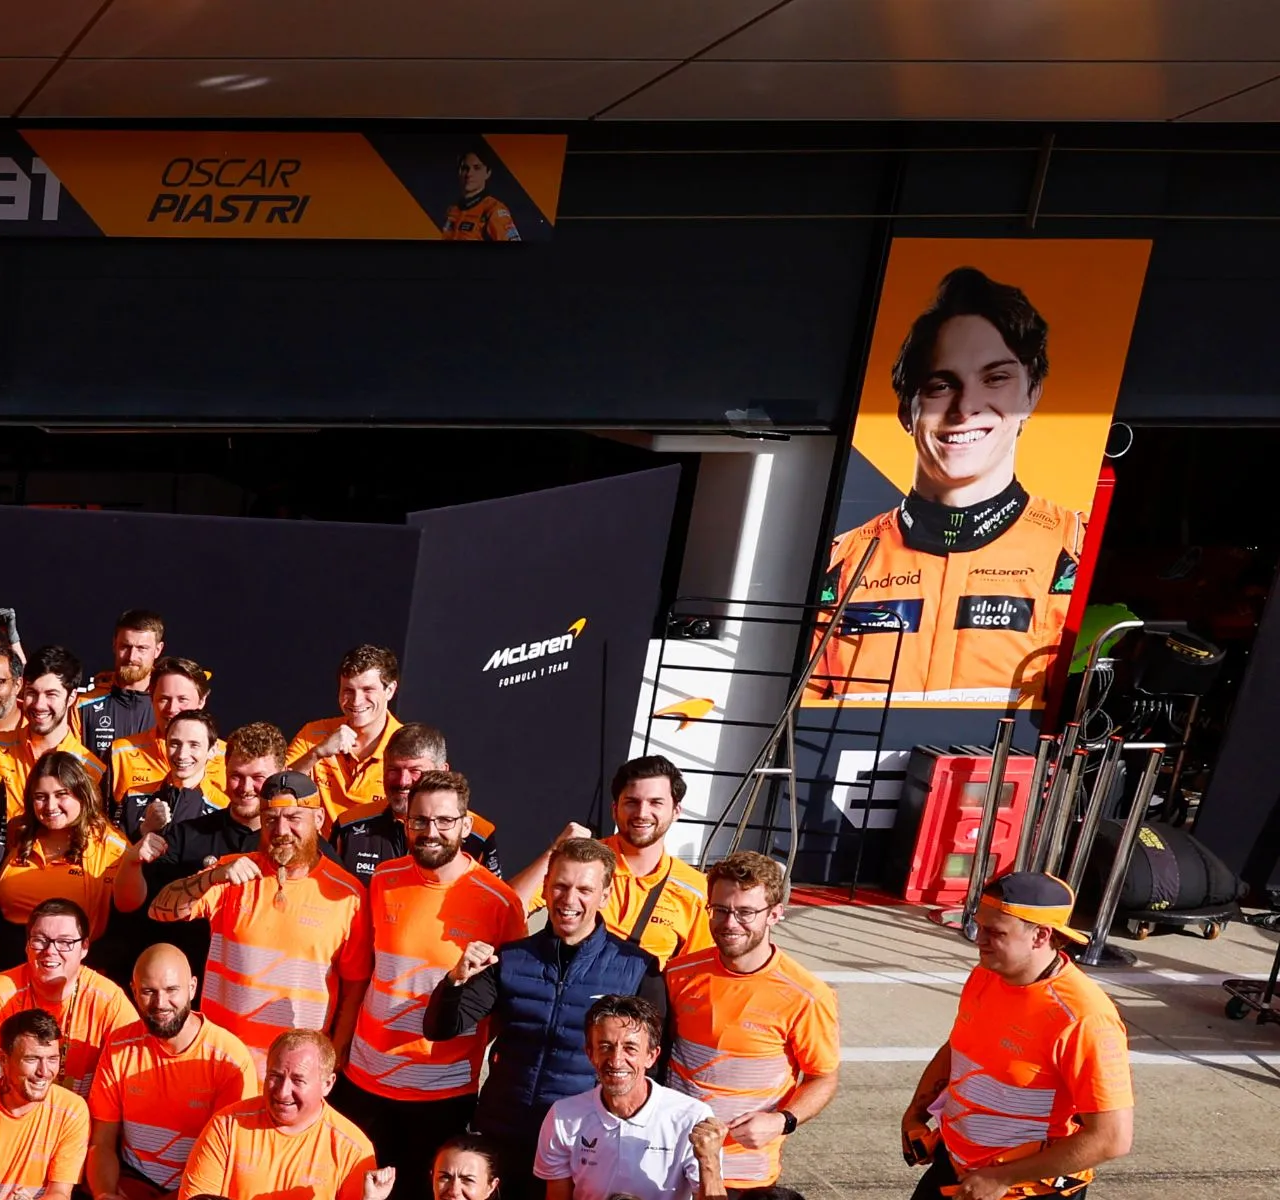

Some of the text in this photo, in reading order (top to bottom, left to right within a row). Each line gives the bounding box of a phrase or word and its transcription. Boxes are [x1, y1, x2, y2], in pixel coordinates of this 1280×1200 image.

[161, 158, 301, 188] OSCAR
[148, 194, 311, 224] PIASTRI
[858, 568, 922, 590] Android
[482, 632, 575, 671] McLaren
[498, 670, 537, 688] FORMULA
[548, 661, 569, 674] TEAM
